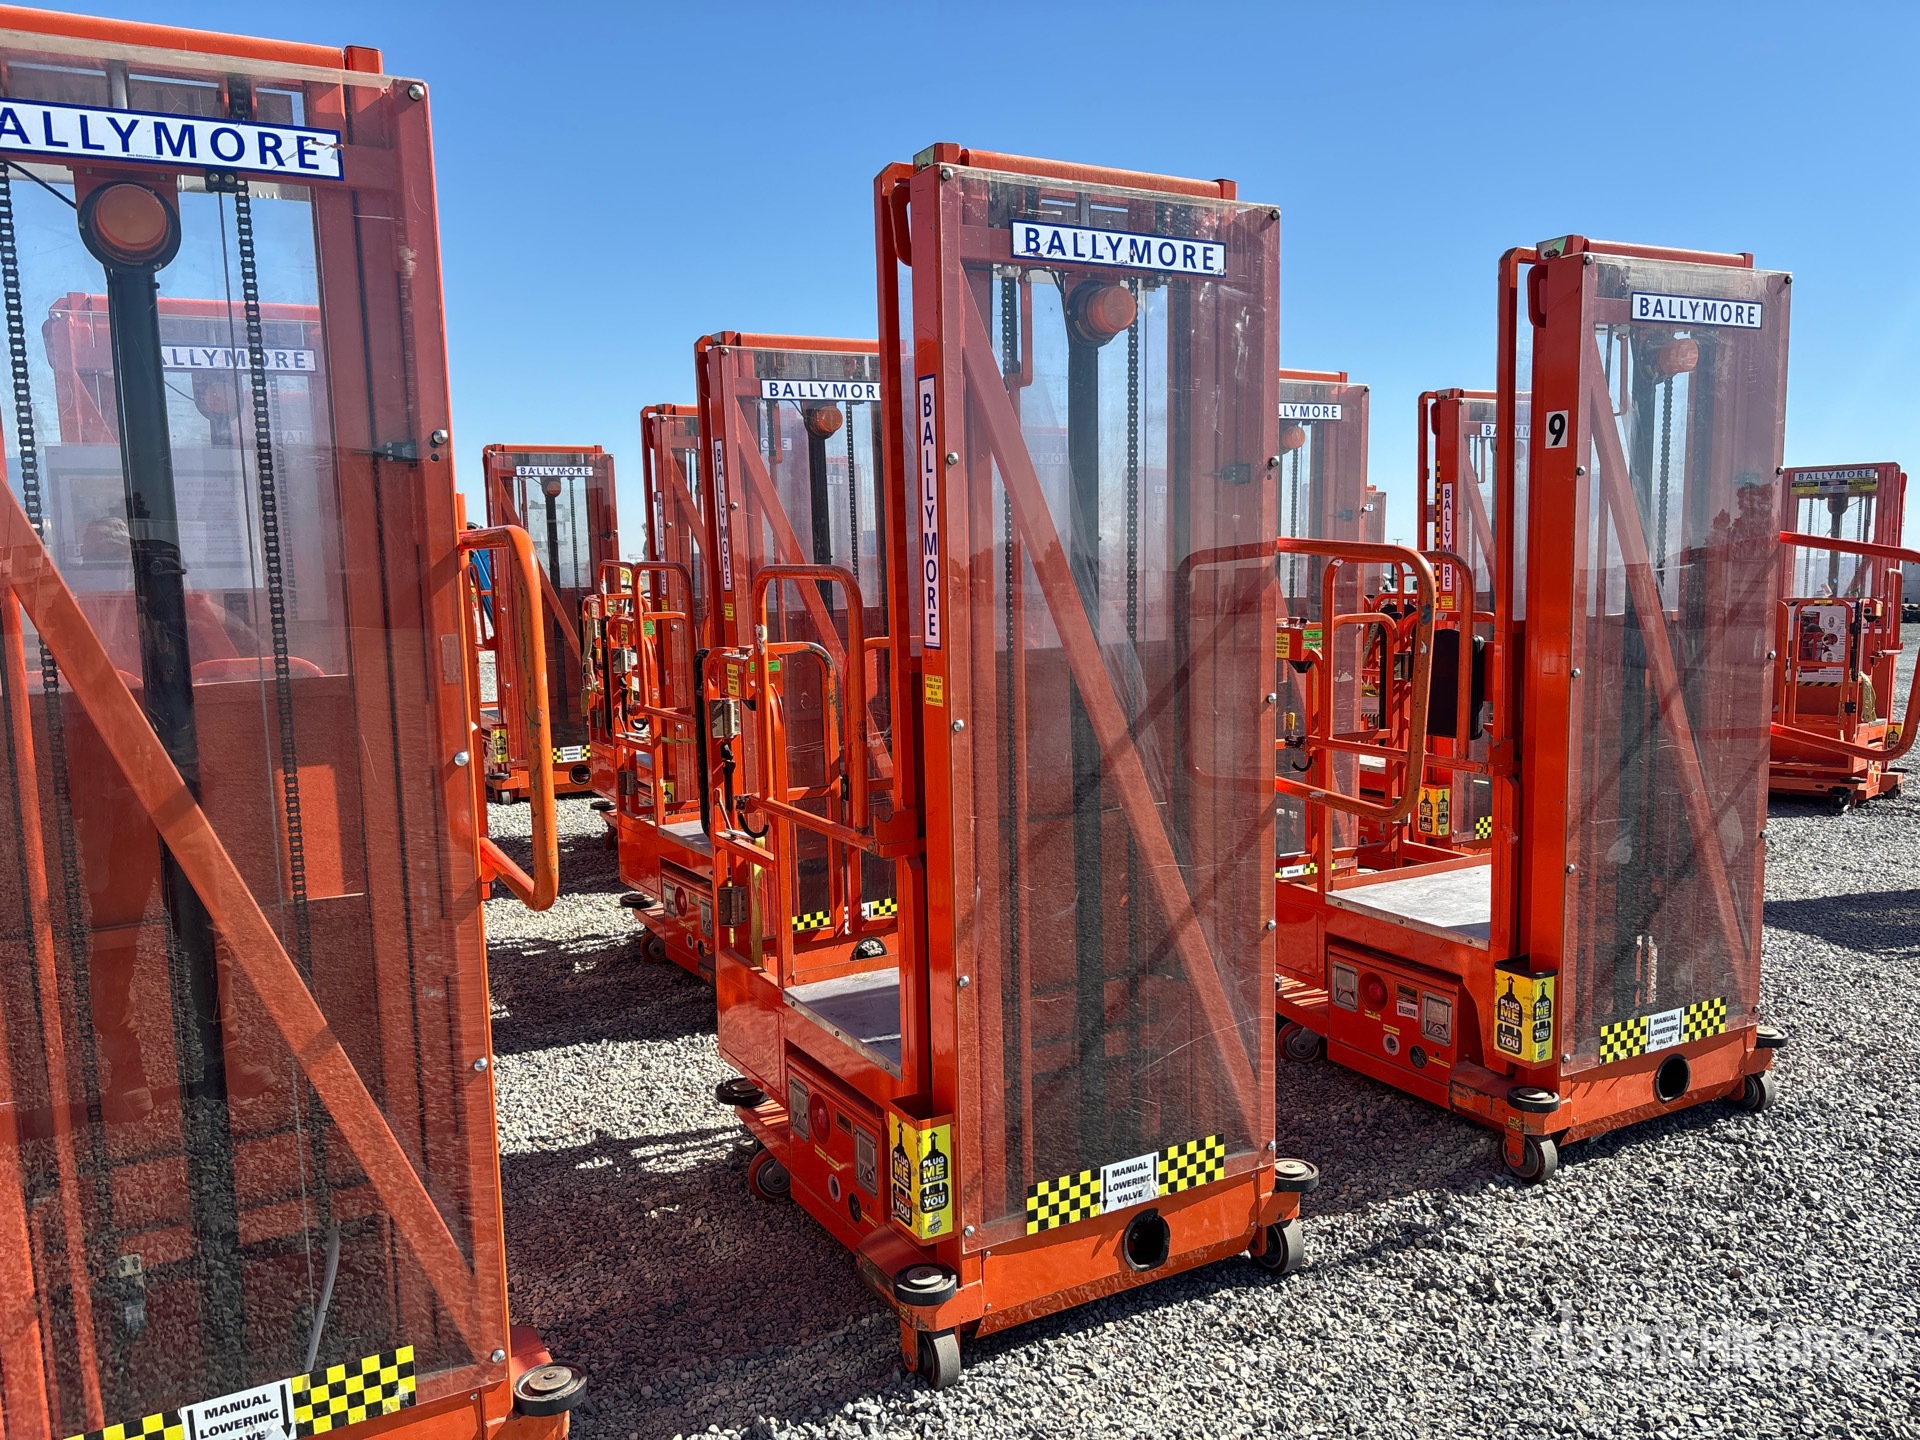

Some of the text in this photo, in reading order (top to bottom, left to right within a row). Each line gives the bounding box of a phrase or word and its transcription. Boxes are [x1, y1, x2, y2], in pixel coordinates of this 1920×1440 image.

[0, 105, 320, 170] ALLYMORE
[1025, 226, 1215, 271] BALLYMORE
[1639, 297, 1756, 325] BALLYMORE
[769, 382, 882, 399] BALLYMOR
[1279, 405, 1338, 418] LYMORE
[1548, 413, 1566, 446] 9
[520, 466, 590, 476] BALLYMORE
[1798, 469, 1871, 481] BALLYMORE
[716, 448, 730, 585] BALLYMORE
[923, 393, 938, 637] BALLYMORE
[1443, 488, 1452, 588] BALLYMRE
[1500, 998, 1520, 1010] PLUG
[1535, 1006, 1550, 1017] ME
[1536, 1000, 1550, 1008] PLUG
[1500, 1006, 1520, 1021] ME
[1653, 1014, 1677, 1025] MANUAL
[1535, 1029, 1549, 1039] YOU
[1650, 1024, 1679, 1036] LOWERING
[1500, 1034, 1519, 1049] YOU
[893, 1150, 909, 1168] PLUG
[922, 1155, 945, 1168] PLUG
[894, 1160, 909, 1183] ME
[922, 1163, 945, 1180] ME
[929, 1174, 945, 1182] TODAY
[1111, 1161, 1149, 1178] MANUAL
[1108, 1173, 1152, 1193] LOWERING
[923, 1194, 946, 1208] YOU
[1116, 1189, 1144, 1203] VALVE
[895, 1198, 911, 1219] YOU
[204, 1393, 272, 1420] MANUAL
[200, 1409, 280, 1440] LOWERING
